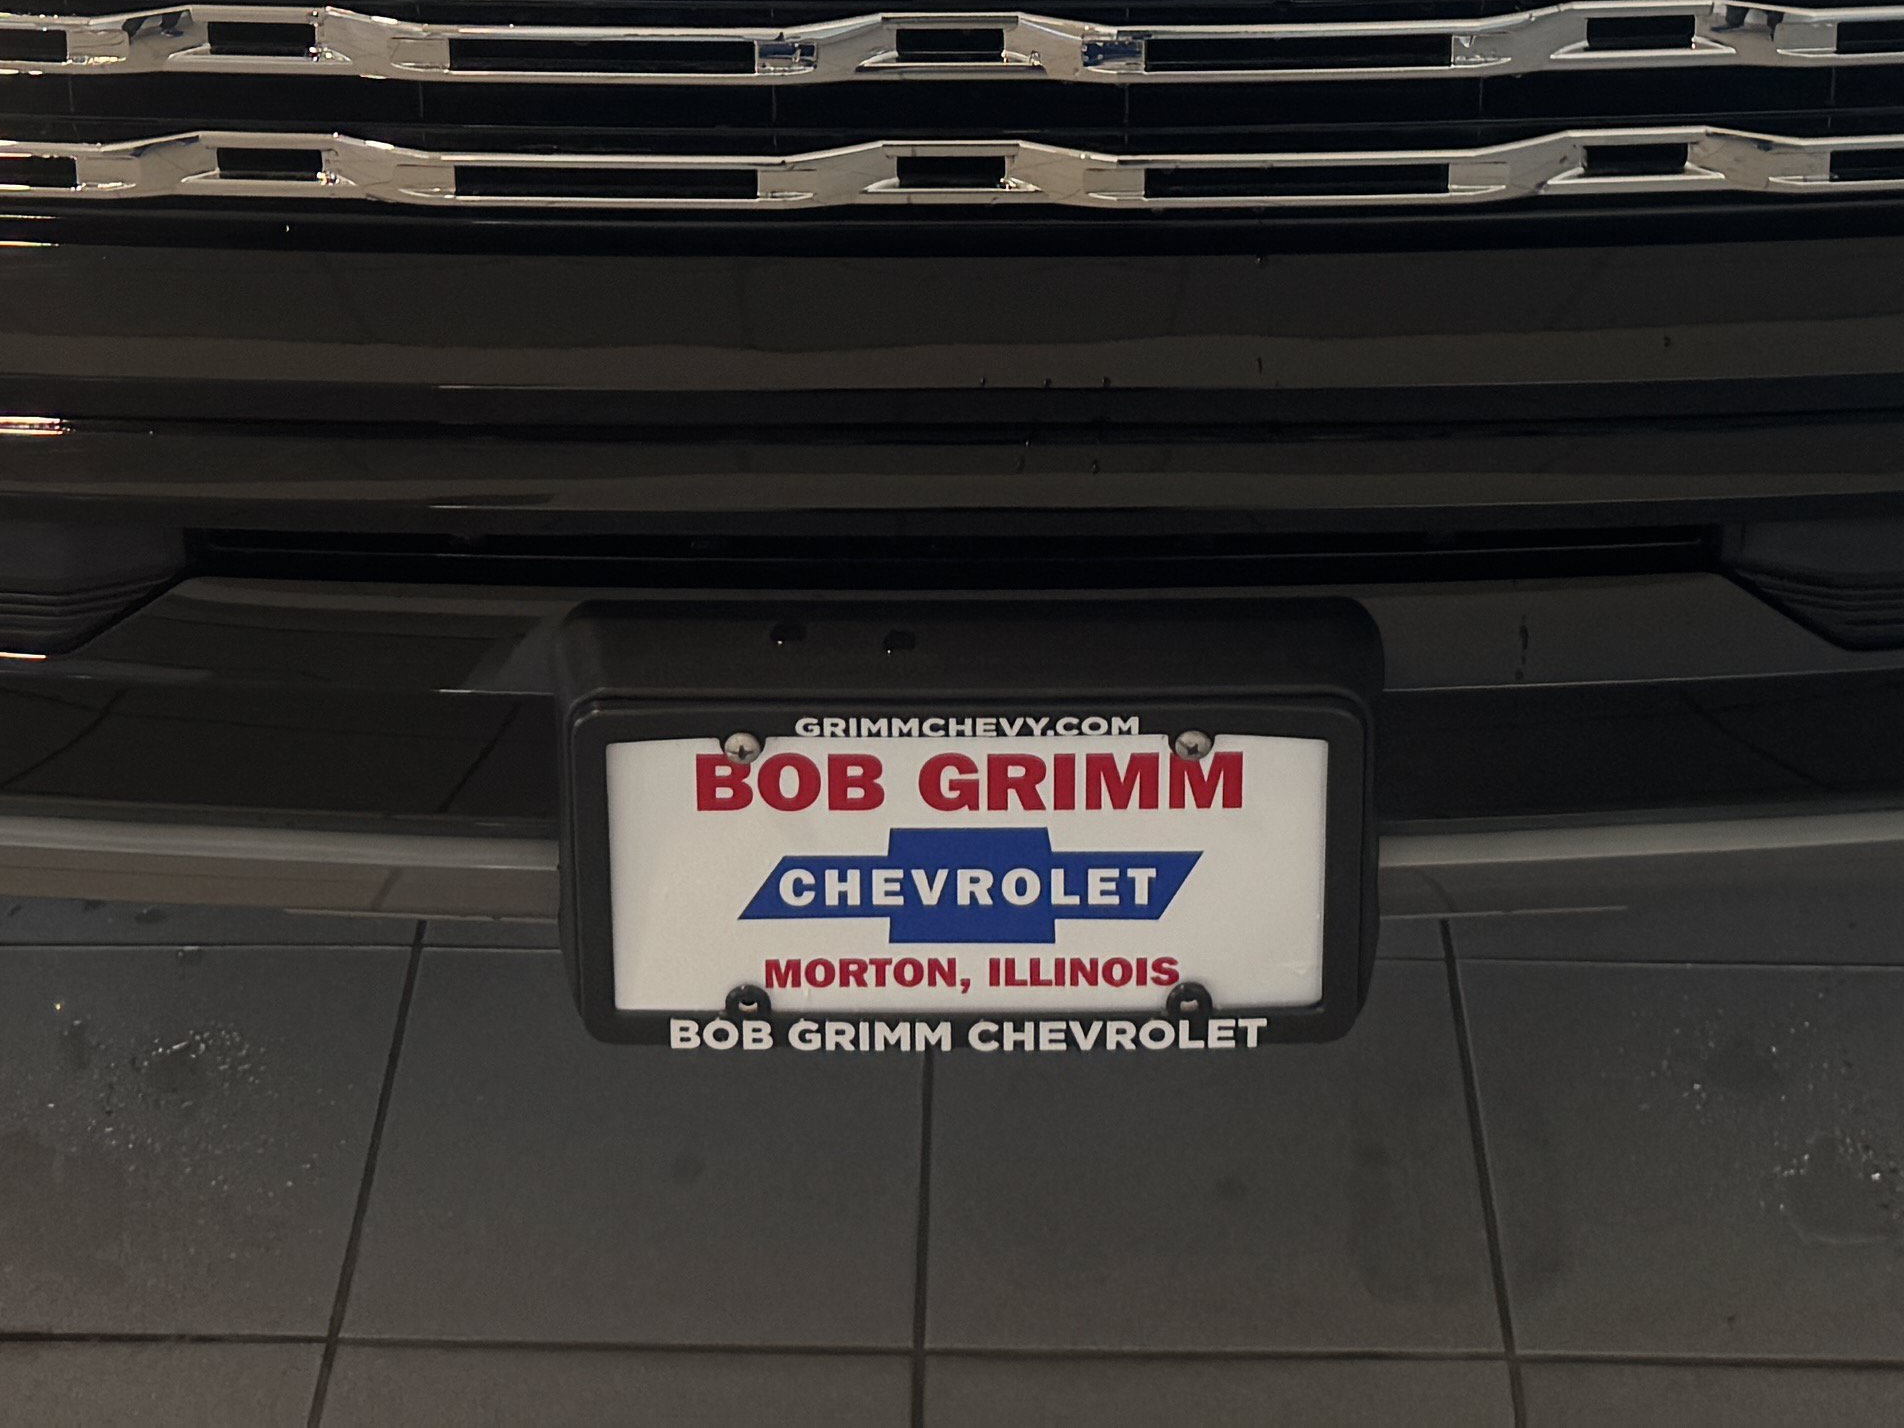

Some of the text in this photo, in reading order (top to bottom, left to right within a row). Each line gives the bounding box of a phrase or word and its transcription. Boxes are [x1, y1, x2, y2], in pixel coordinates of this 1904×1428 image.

[795, 716, 1141, 739] GRIMMCHEVY.COM
[696, 751, 1244, 811] BOB GRIMM
[778, 867, 1158, 907] CHEVROLET
[764, 956, 1180, 994] MORTON, ILLINOIS
[670, 1017, 1268, 1053] BOB GRIMM CHEVROLET
